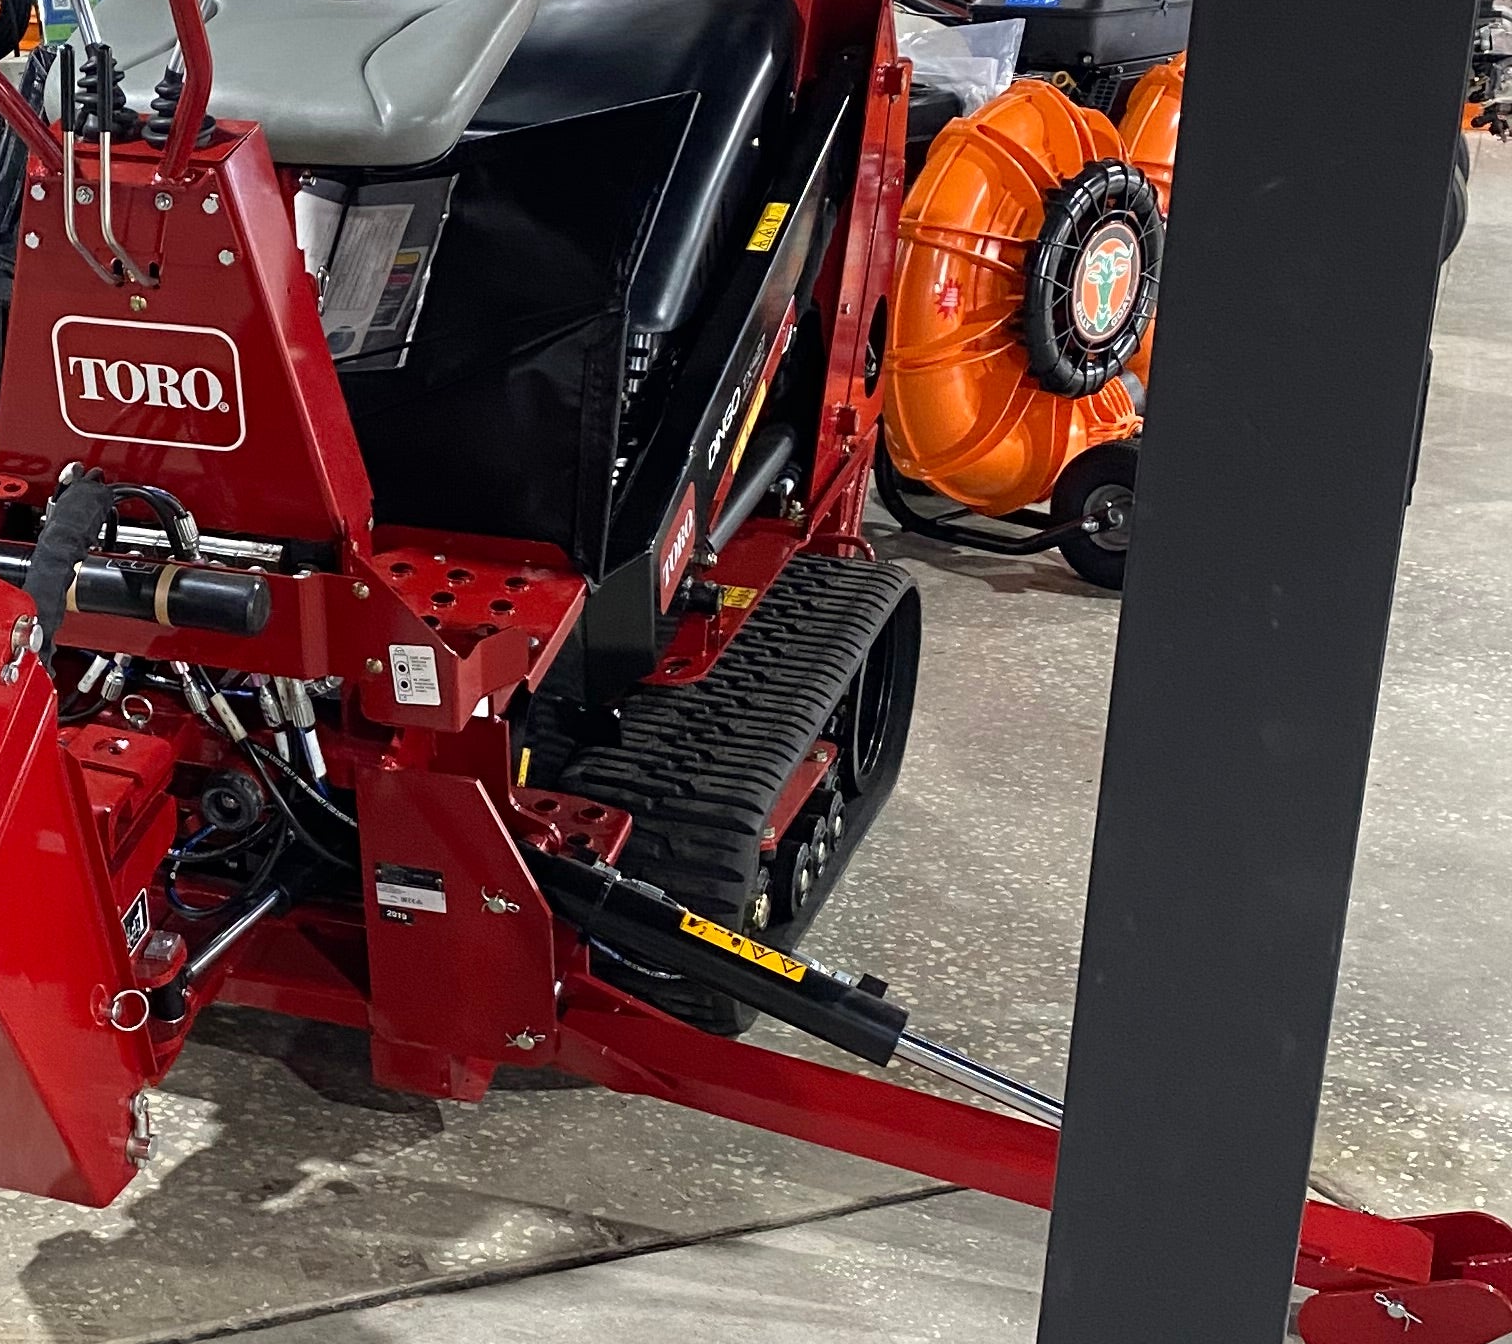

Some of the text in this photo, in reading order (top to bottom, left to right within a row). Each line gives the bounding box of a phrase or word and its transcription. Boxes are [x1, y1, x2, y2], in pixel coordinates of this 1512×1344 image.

[1110, 296, 1131, 327] GOAT
[68, 355, 225, 412] TORO
[662, 508, 693, 587] TORO
